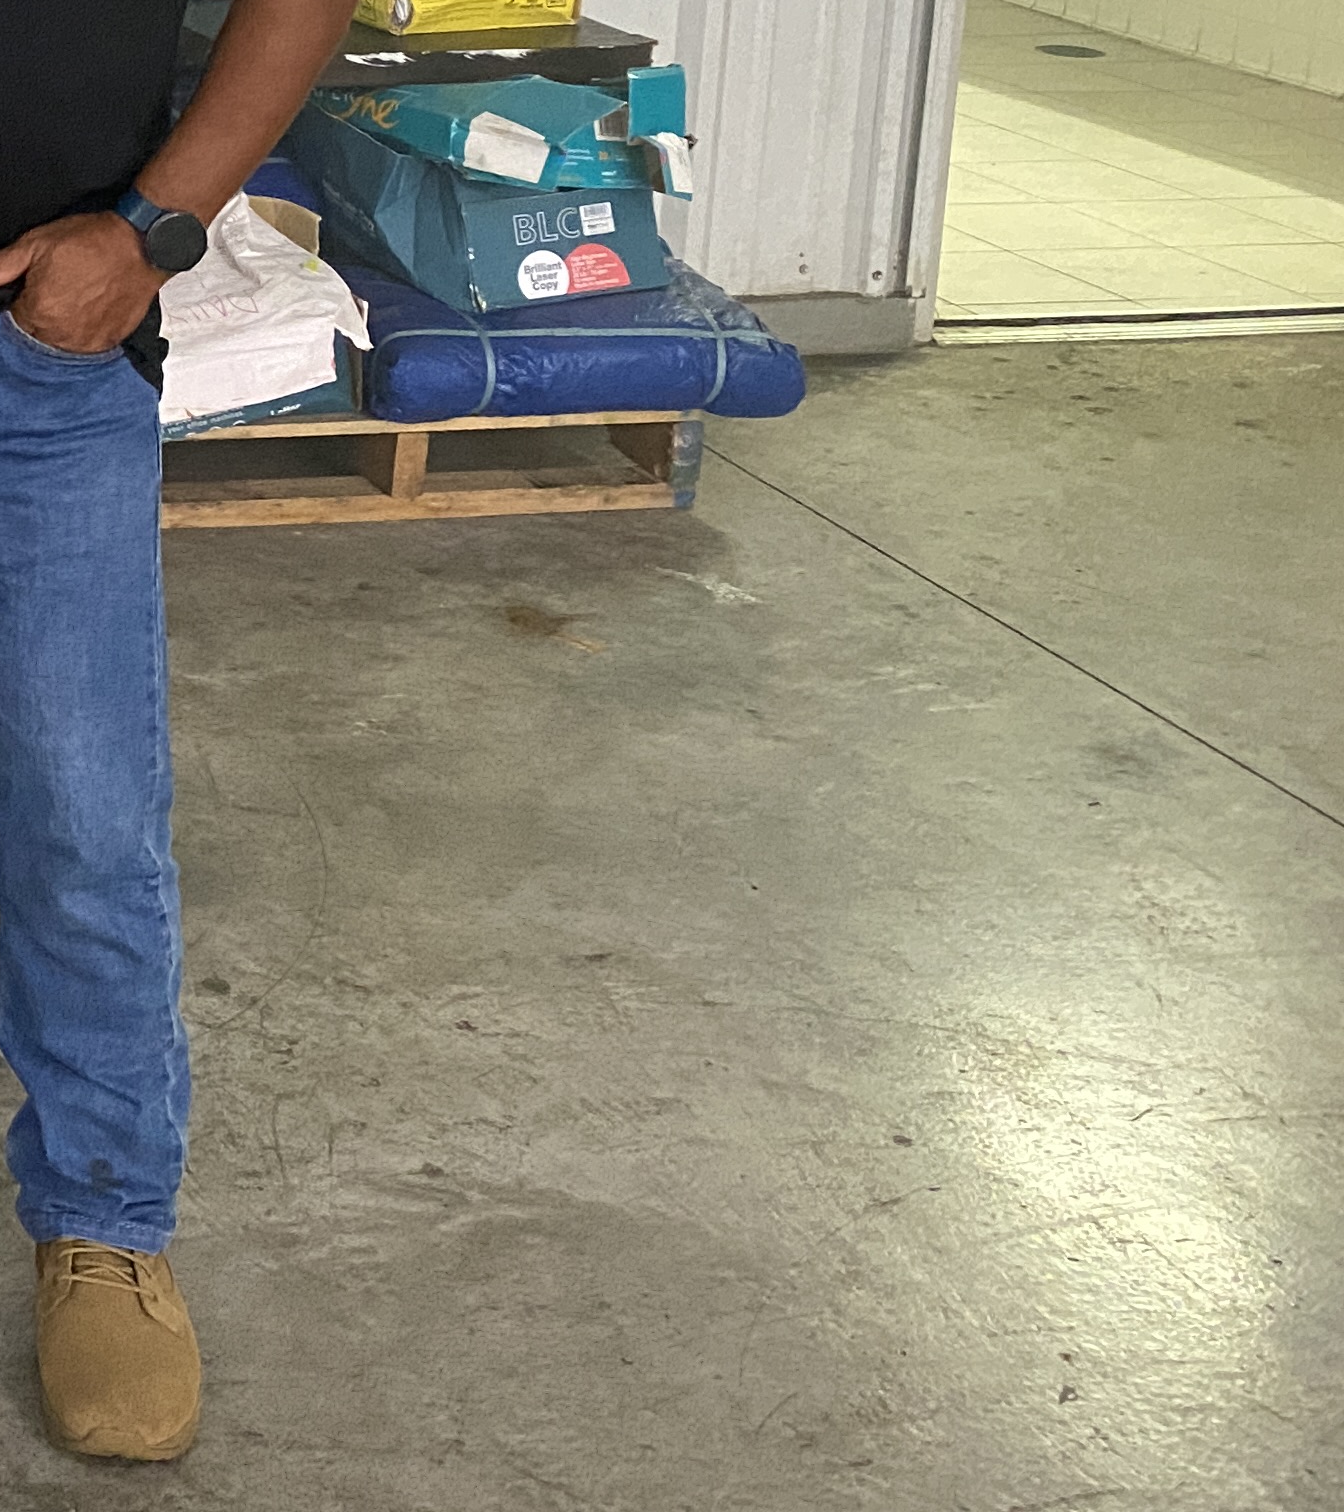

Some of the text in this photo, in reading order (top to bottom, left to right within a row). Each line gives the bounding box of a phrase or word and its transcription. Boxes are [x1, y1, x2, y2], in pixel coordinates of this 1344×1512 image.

[513, 207, 581, 246] BLC
[524, 261, 562, 275] Brilliant
[530, 272, 558, 283] Laser
[532, 281, 558, 292] Copy
